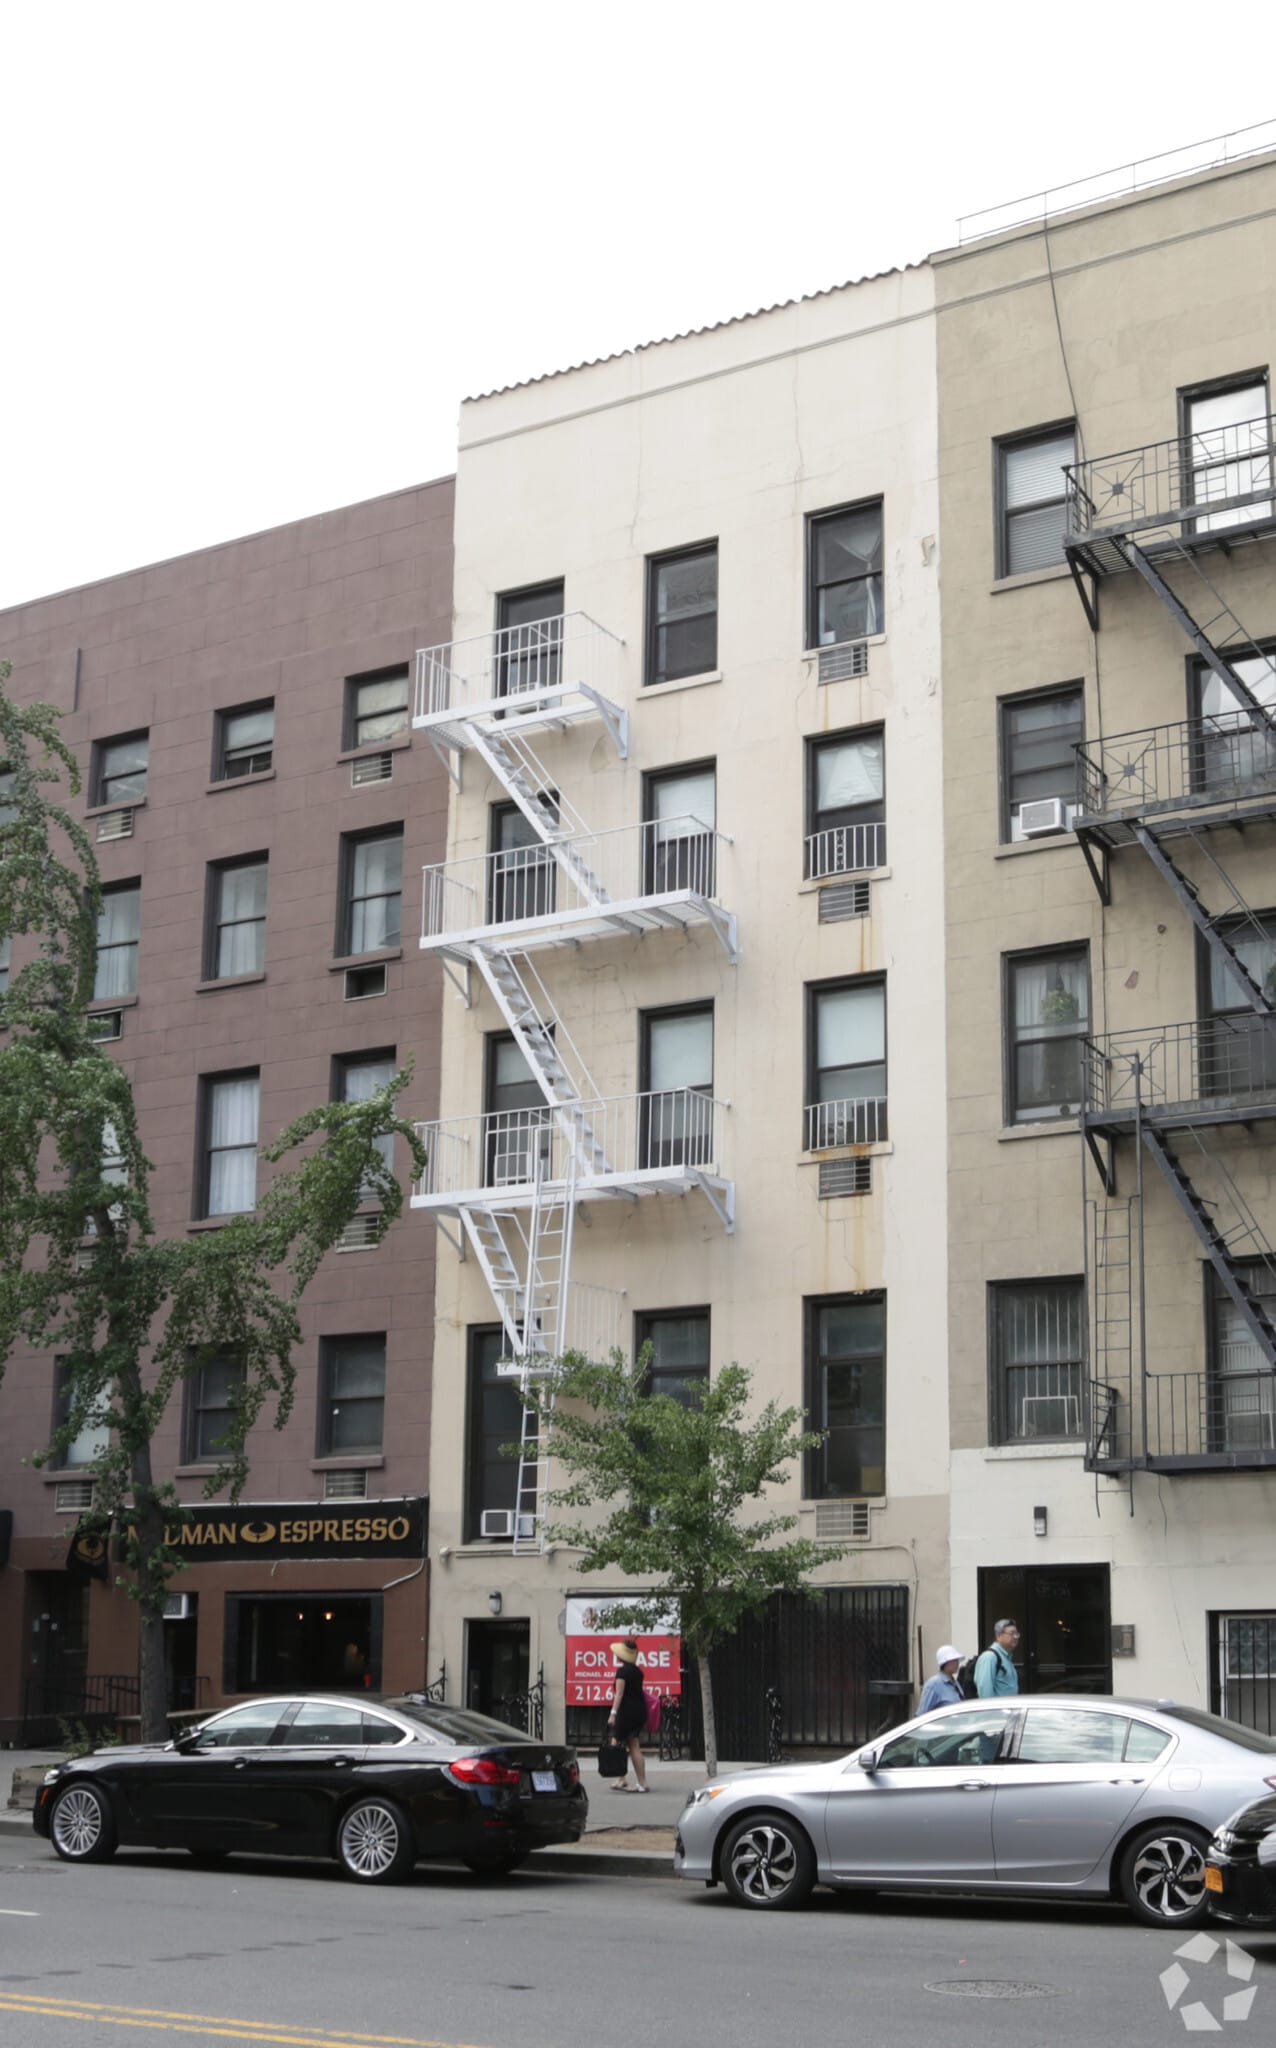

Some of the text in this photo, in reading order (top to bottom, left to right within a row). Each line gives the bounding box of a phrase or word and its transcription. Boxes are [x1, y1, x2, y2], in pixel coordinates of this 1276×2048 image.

[280, 1518, 410, 1543] ESPRESSO
[575, 1651, 671, 1667] FOR LASE
